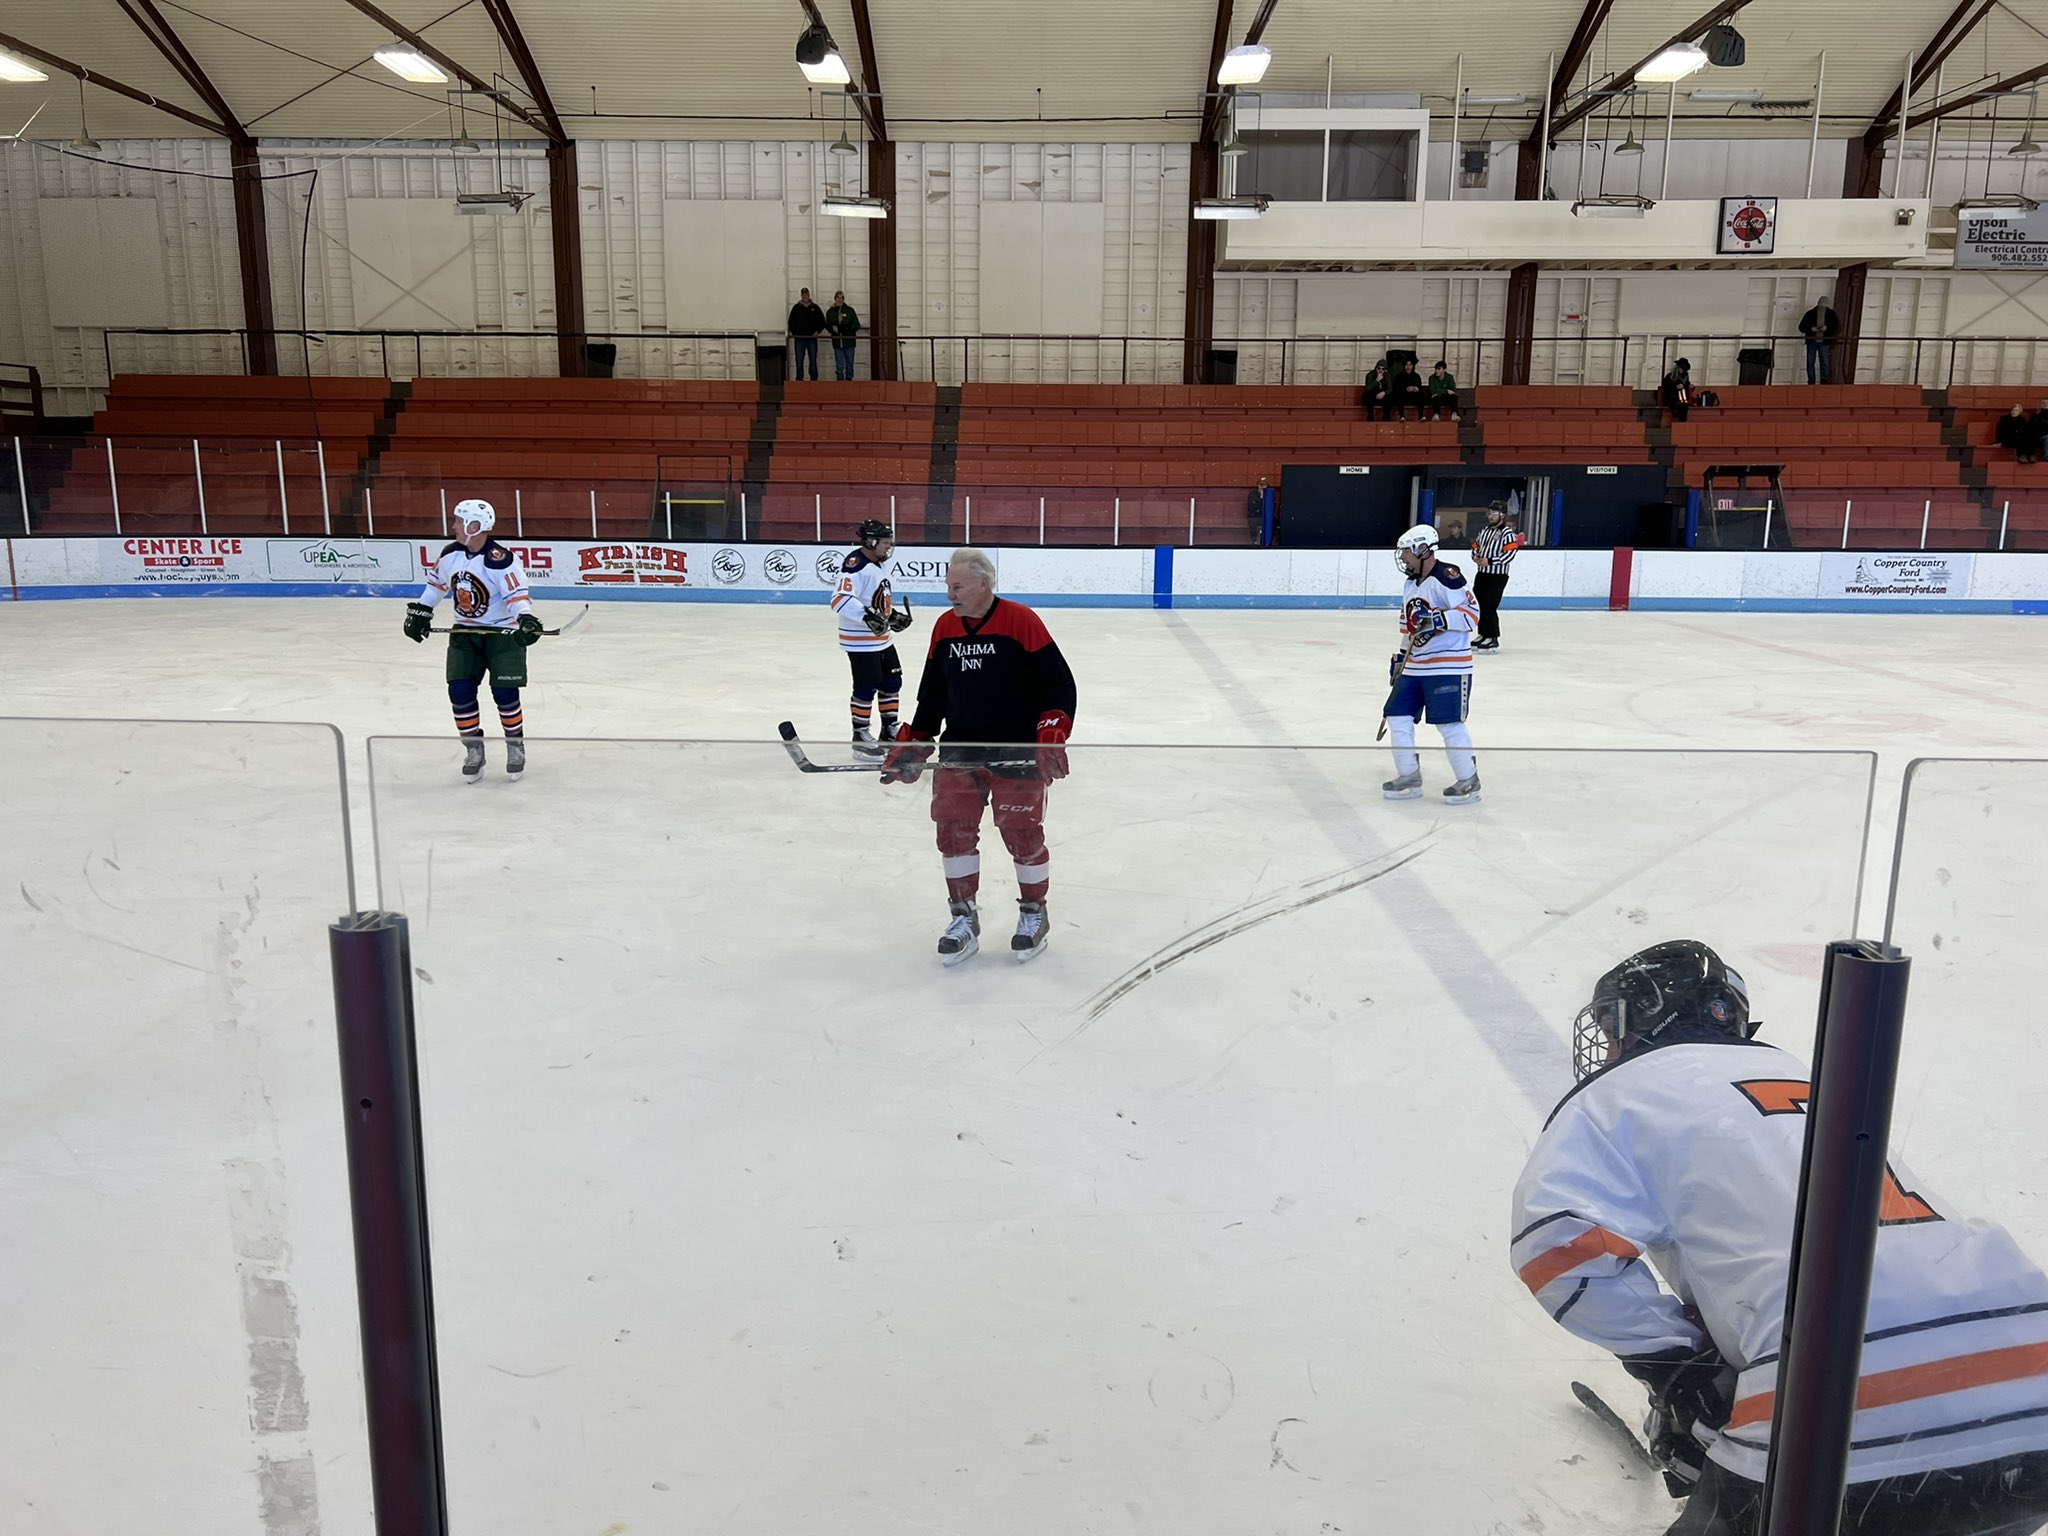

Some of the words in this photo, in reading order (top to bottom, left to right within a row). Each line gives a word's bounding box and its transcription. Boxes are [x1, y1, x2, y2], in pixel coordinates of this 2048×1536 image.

[1967, 228, 2026, 241] Electric
[1975, 245, 2018, 254] Electrical
[1991, 253, 2048, 262] 906.482.552
[123, 539, 204, 555] CENTER
[210, 539, 242, 555] ICE
[182, 557, 189, 565] &
[193, 558, 216, 566] Sport
[304, 551, 338, 563] UPEA
[1874, 559, 1908, 568] Copper
[1909, 559, 1948, 568] Country
[1899, 568, 1921, 577] Ford
[504, 571, 520, 592] 11
[837, 577, 853, 592] 16
[1845, 584, 1947, 596] www.CopperCountryFord.com
[949, 643, 996, 658] NAHMA
[961, 657, 982, 671] INN
[999, 804, 1034, 812] CCM
[1651, 1011, 1679, 1037] BAUER
